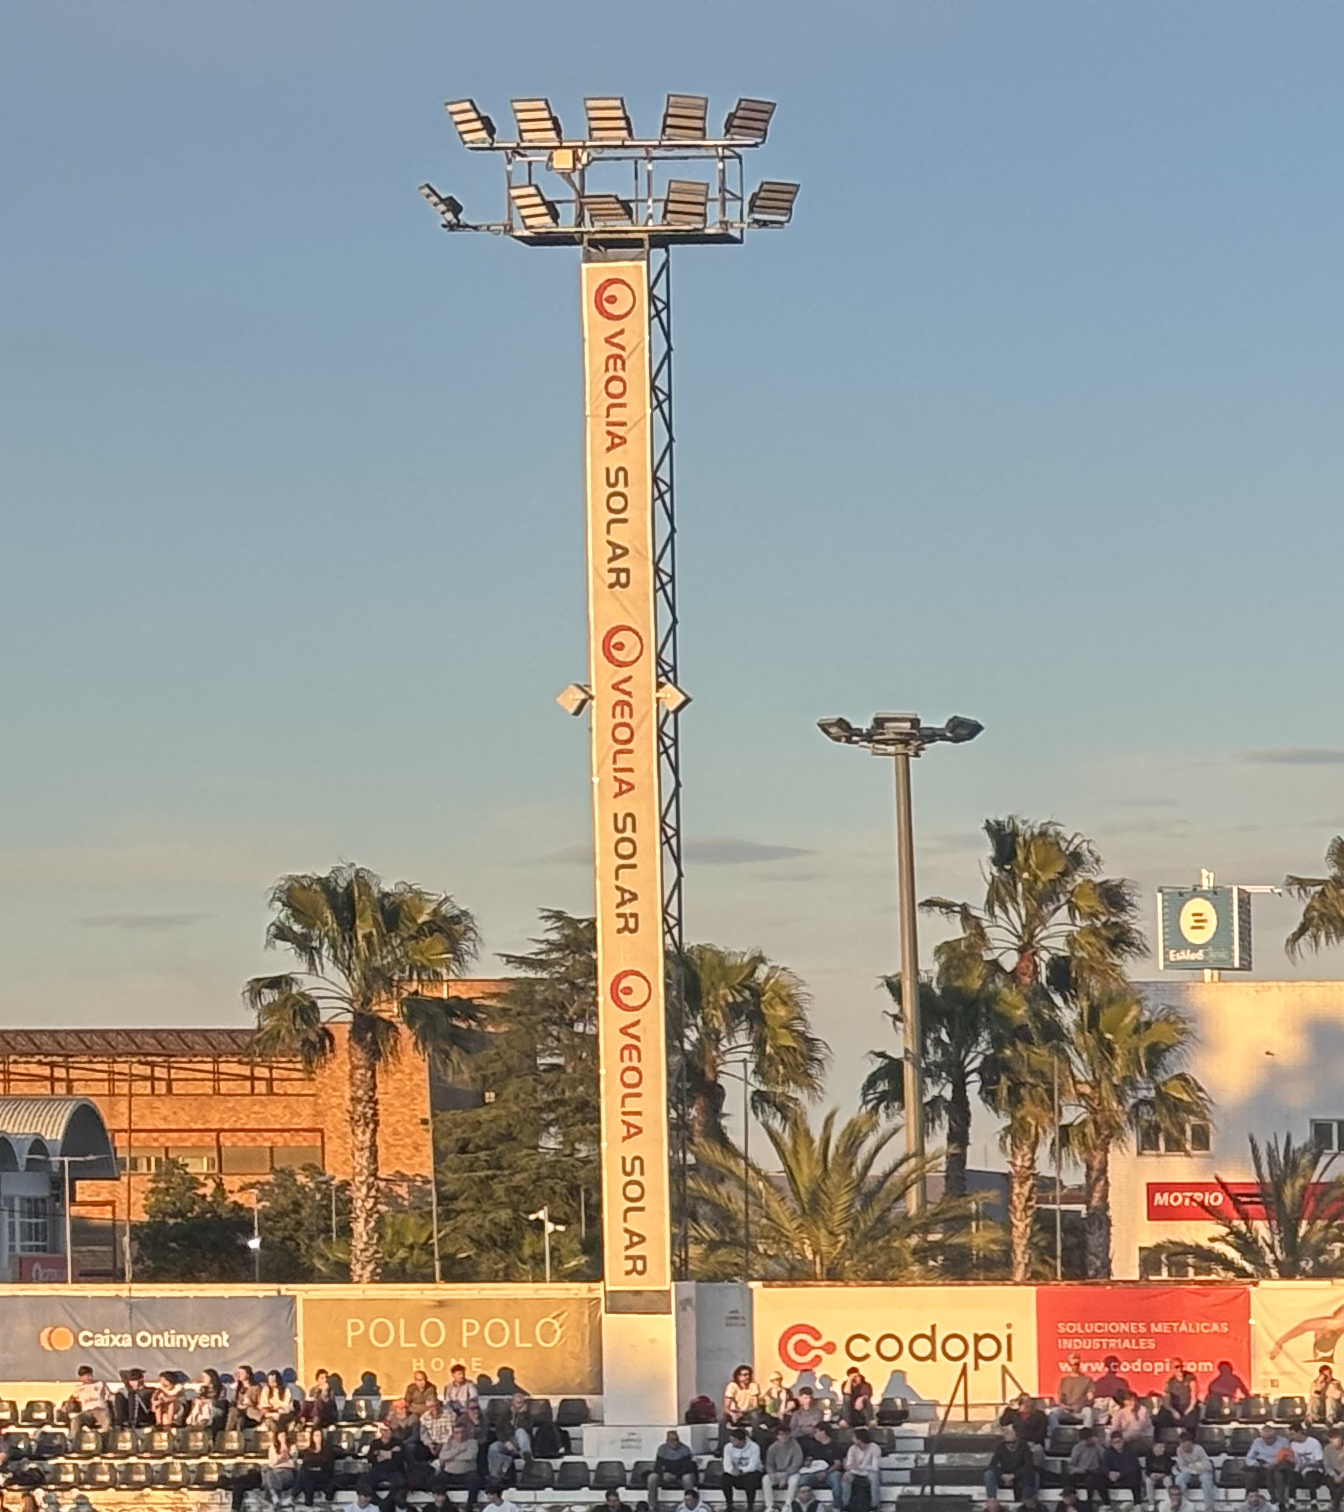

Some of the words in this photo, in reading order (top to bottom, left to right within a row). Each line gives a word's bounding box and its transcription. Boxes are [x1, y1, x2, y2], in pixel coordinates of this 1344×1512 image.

[603, 328, 628, 453] VEOLIA
[604, 466, 631, 590] SOLAR
[610, 676, 636, 799] VEOLIA
[612, 812, 639, 935] SOLAR
[618, 1019, 644, 1143] VEOLIA
[620, 1155, 648, 1277] SOLAR
[78, 1328, 132, 1348] Caixa
[136, 1329, 229, 1352] Ontinyent
[346, 1317, 446, 1348] POLO
[462, 1317, 561, 1348] POLO
[845, 1323, 1013, 1370] codopi
[1057, 1321, 1147, 1334] SOLUCIONES
[1150, 1319, 1229, 1333] METÁLICAS
[1057, 1338, 1156, 1350] INDUSTRIALES
